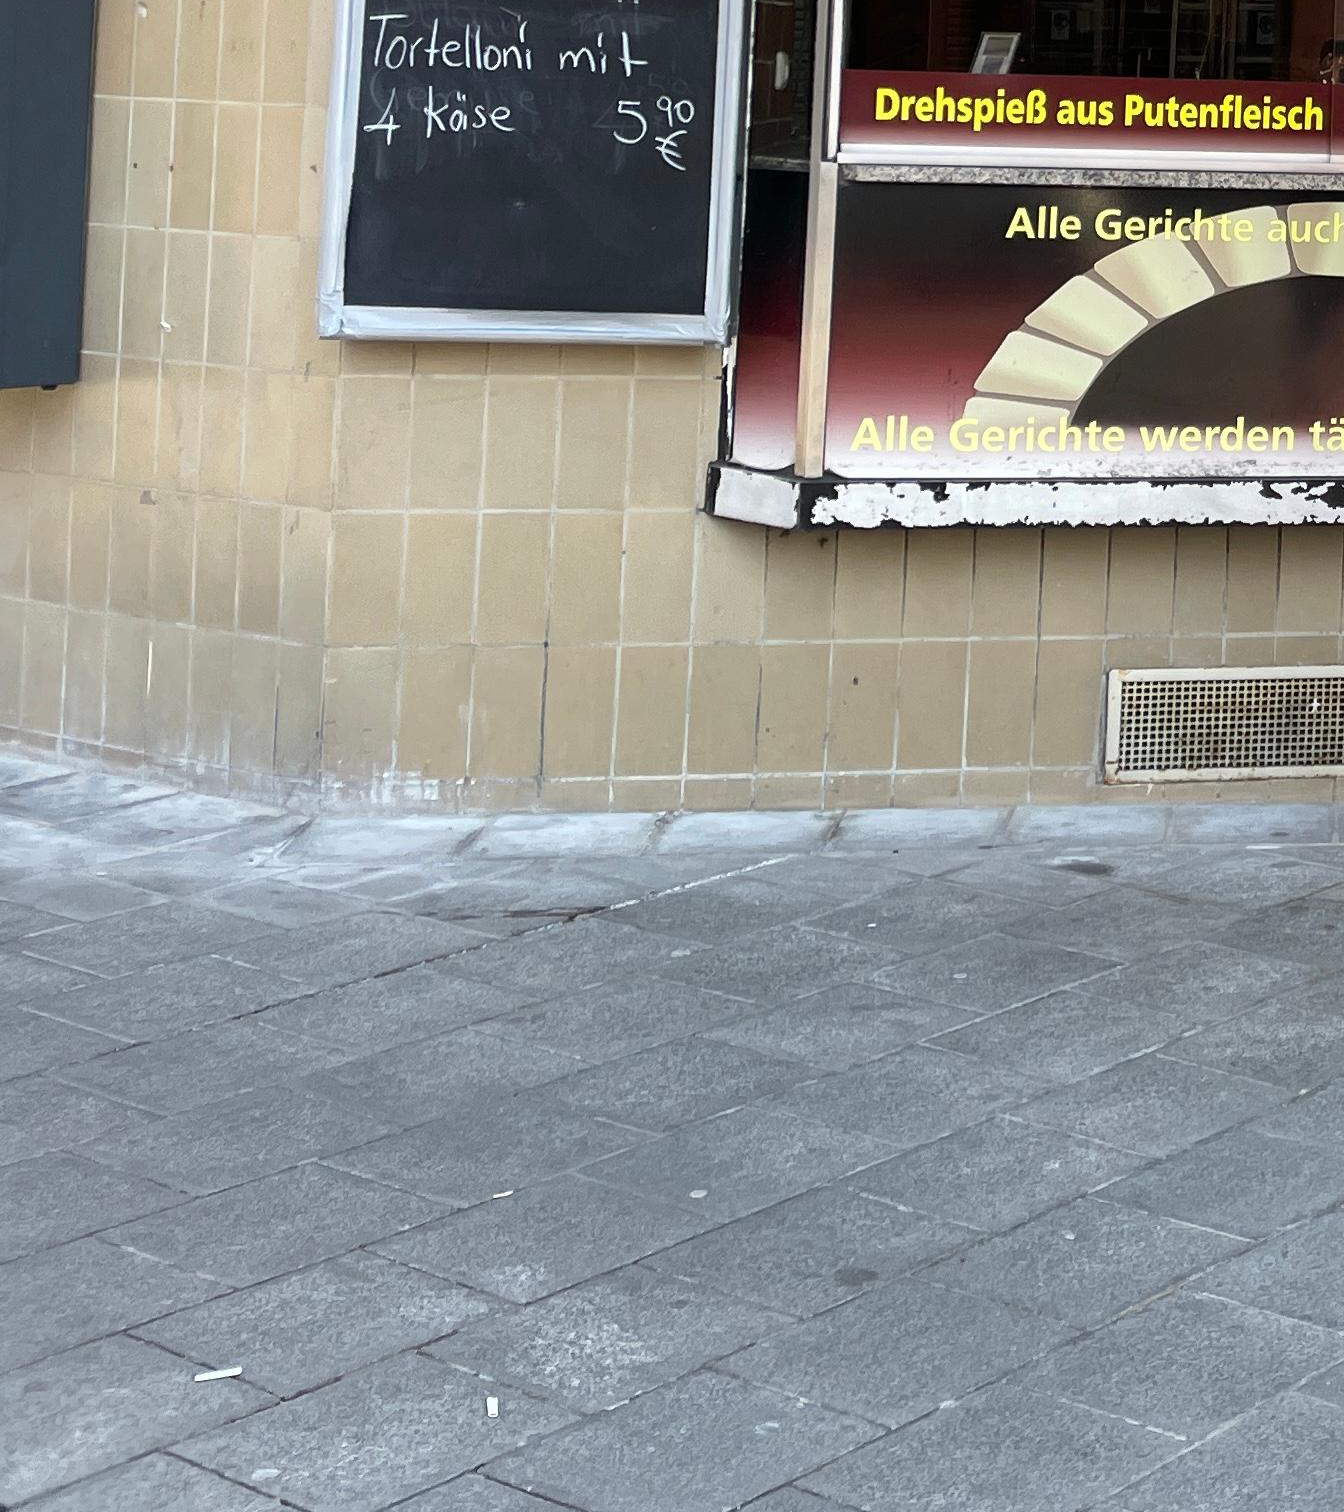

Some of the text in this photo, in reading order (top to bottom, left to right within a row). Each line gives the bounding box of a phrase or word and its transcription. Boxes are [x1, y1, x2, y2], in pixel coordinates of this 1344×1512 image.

[369, 13, 649, 77] Tortelloni mit
[362, 88, 401, 146] 4
[875, 86, 1324, 132] Drehspieß aus Putenfleisch
[1006, 205, 1082, 243] Alle
[1094, 207, 1253, 244] Gerichte
[851, 414, 937, 454] Alle
[948, 415, 1126, 454] Gerichte
[1140, 419, 1297, 454] werden
